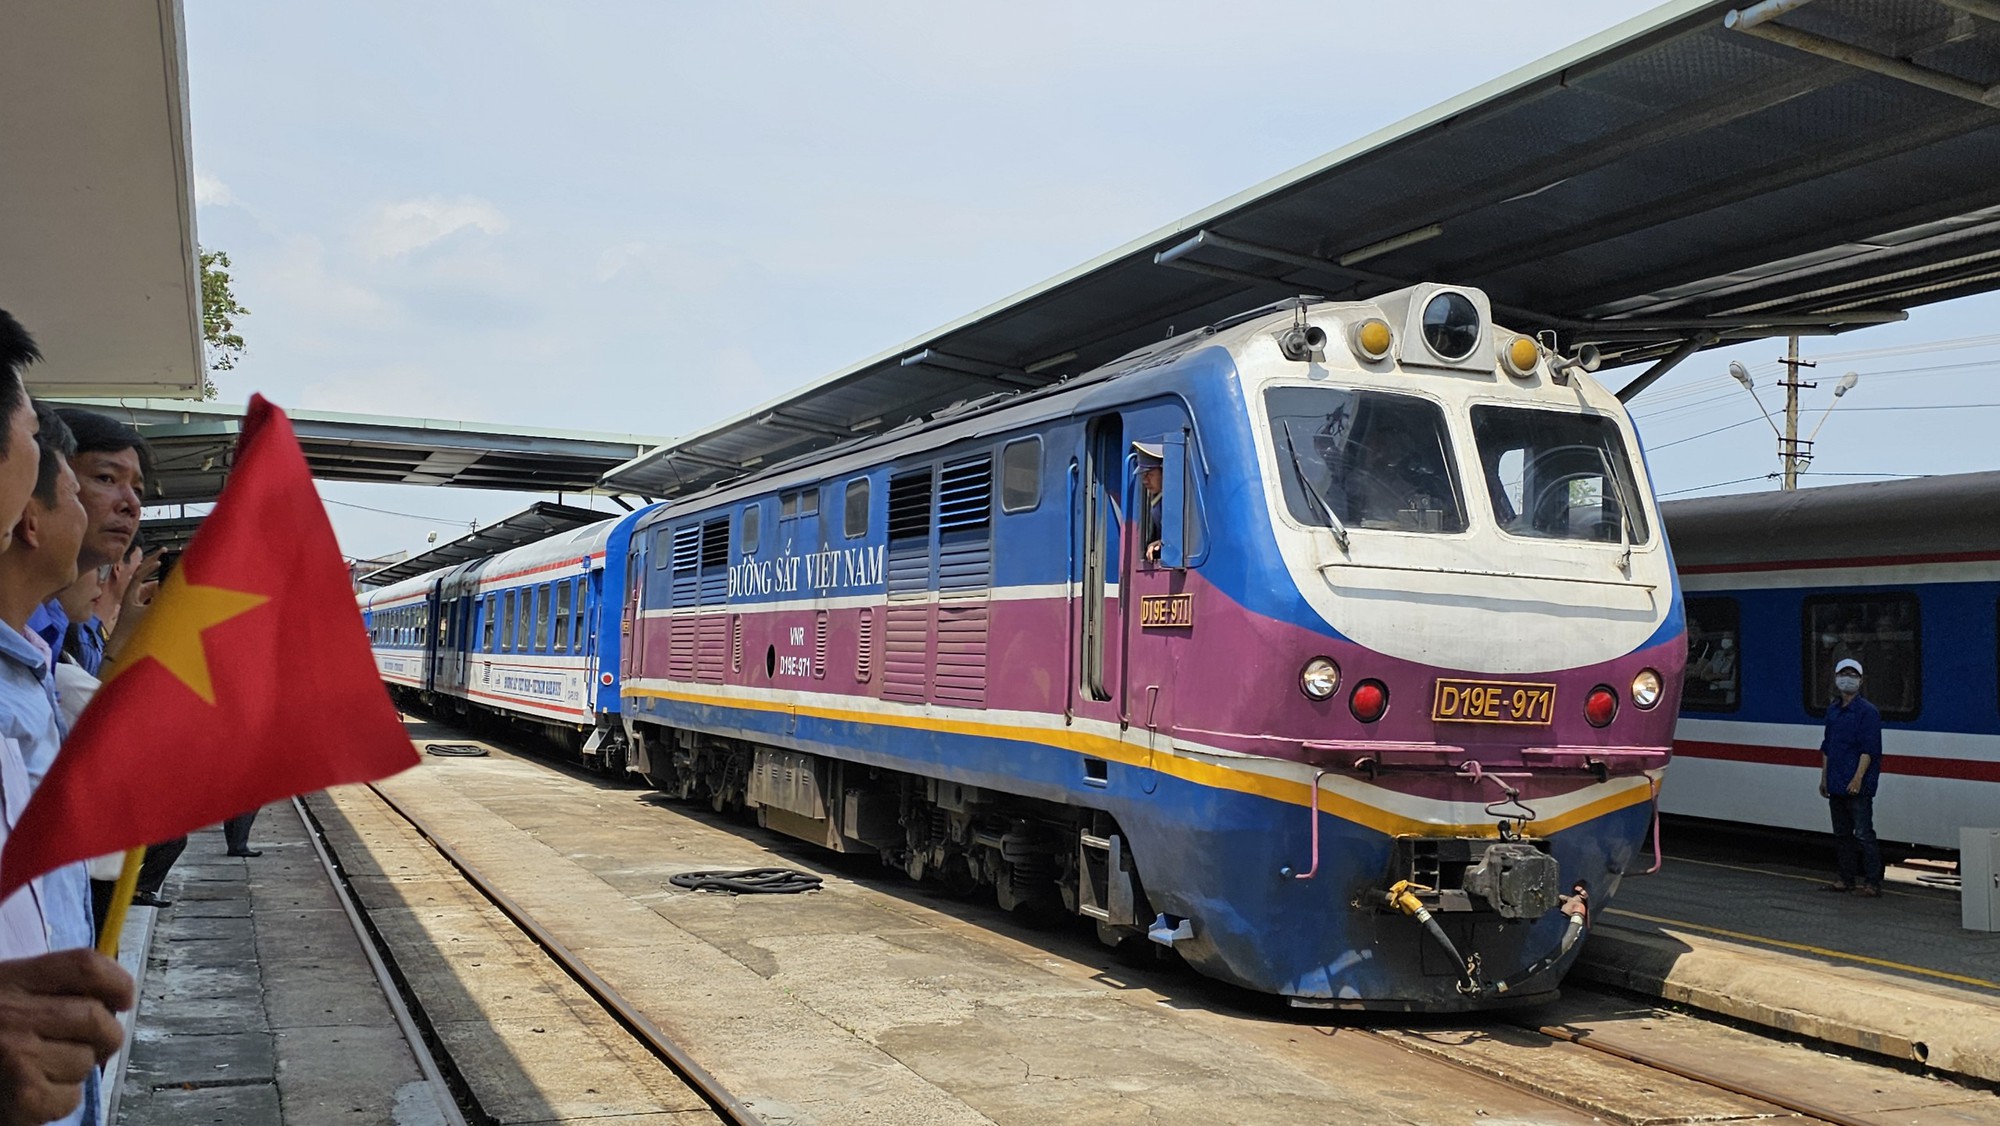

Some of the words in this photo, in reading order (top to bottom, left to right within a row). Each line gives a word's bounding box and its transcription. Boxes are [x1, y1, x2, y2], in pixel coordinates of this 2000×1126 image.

[775, 538, 800, 592] SẮT
[805, 542, 841, 596] VIỆT
[843, 544, 885, 588] NAM
[1143, 599, 1188, 622] D19E-971
[790, 627, 805, 645] VNR
[780, 655, 810, 677] D19E-971
[1440, 686, 1550, 719] D19E-971
